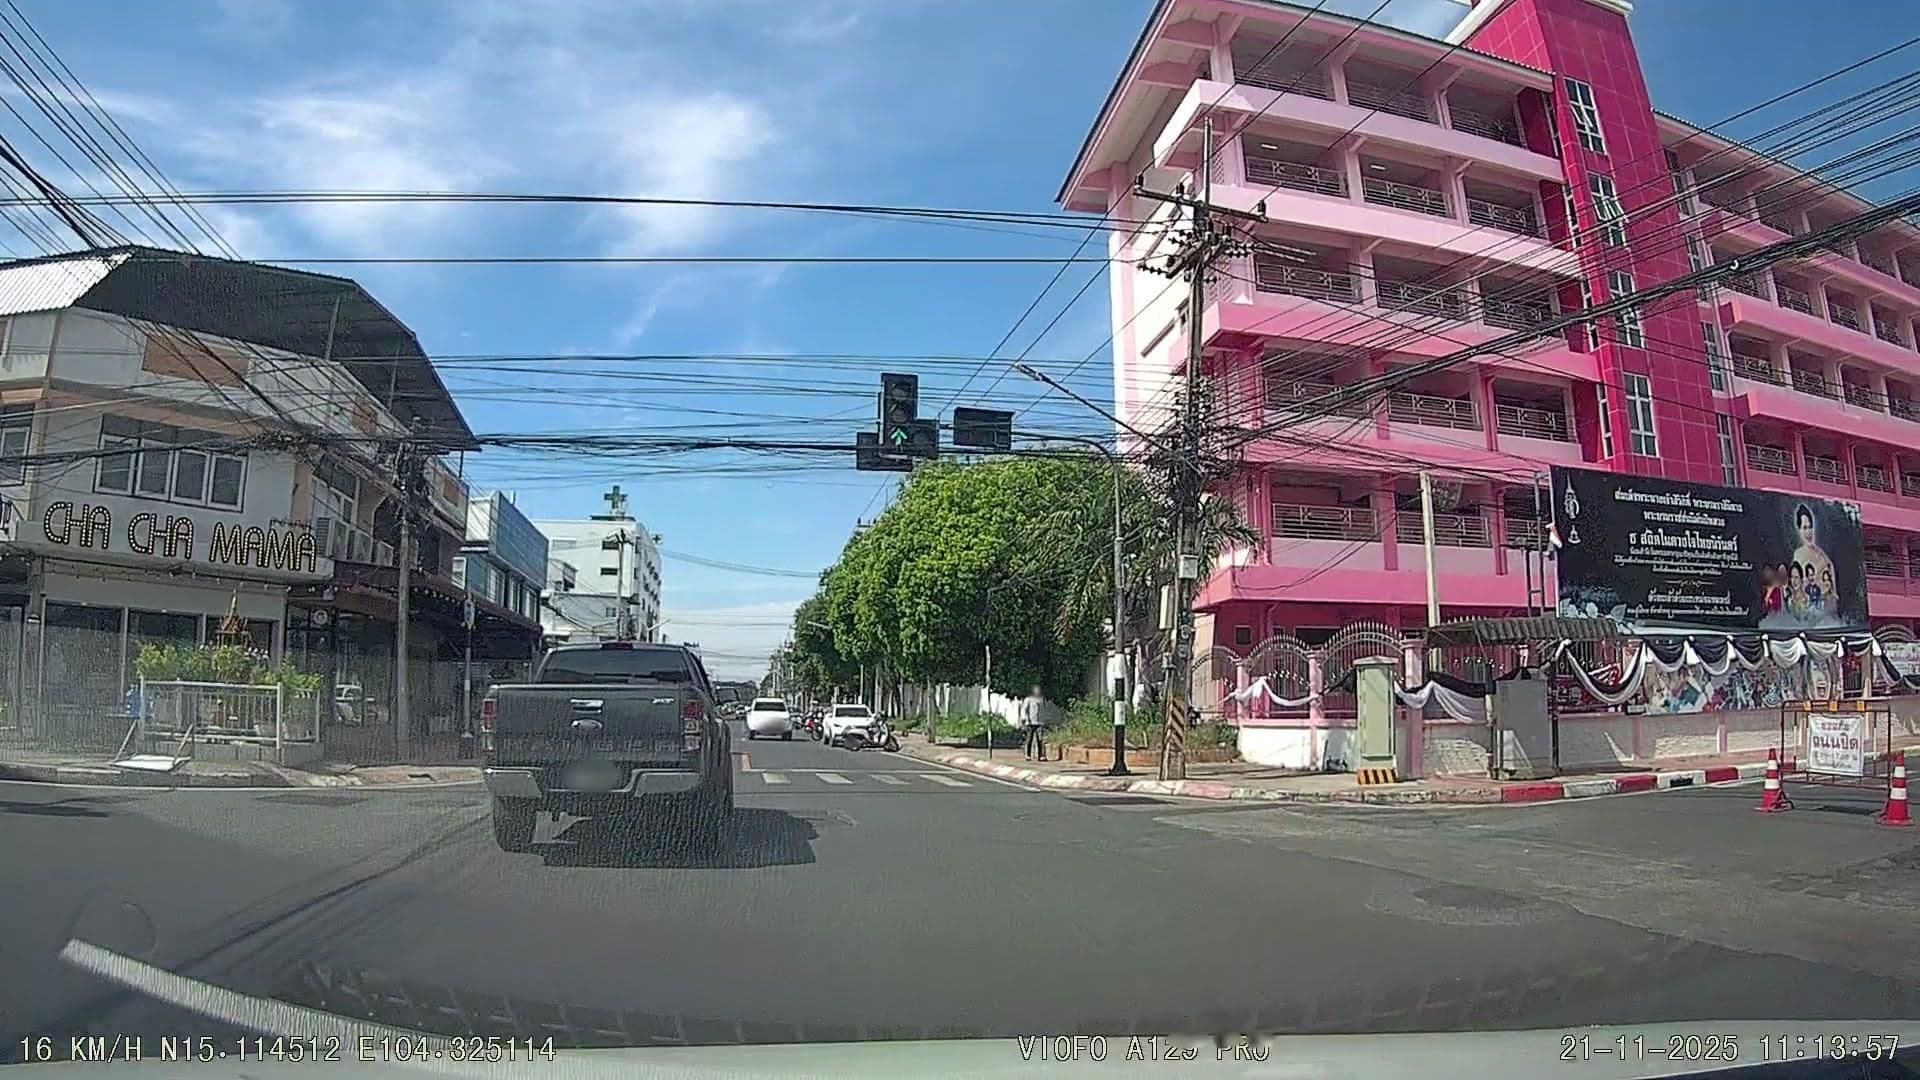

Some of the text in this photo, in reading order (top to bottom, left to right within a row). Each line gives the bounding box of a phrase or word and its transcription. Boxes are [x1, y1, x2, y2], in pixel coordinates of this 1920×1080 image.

[43, 501, 318, 573] CHA CHA MAMA
[1813, 732, 1858, 750] ถนนปิด
